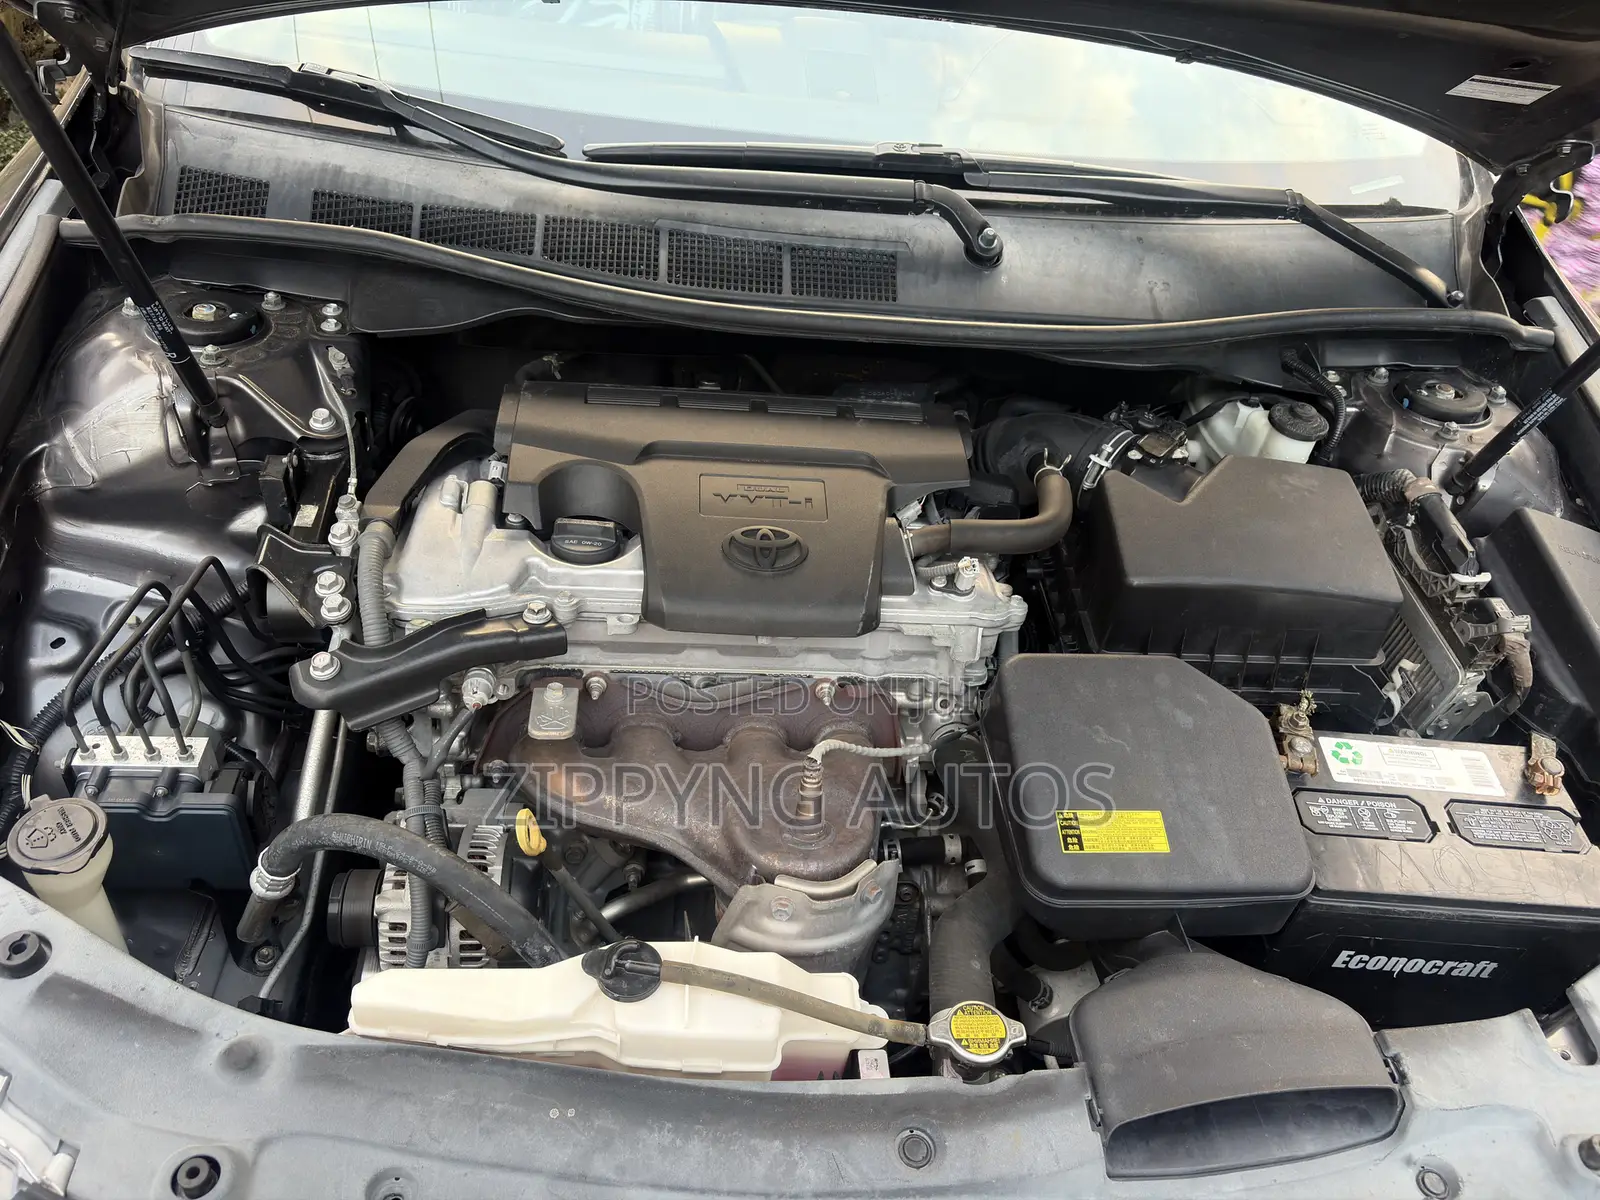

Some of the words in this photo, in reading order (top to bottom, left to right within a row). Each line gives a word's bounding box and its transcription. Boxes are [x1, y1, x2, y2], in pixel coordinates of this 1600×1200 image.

[154, 300, 174, 332] STABILUS
[1325, 797, 1359, 806] DANGER
[1366, 800, 1397, 809] POISON
[1331, 950, 1499, 979] Econocraft
